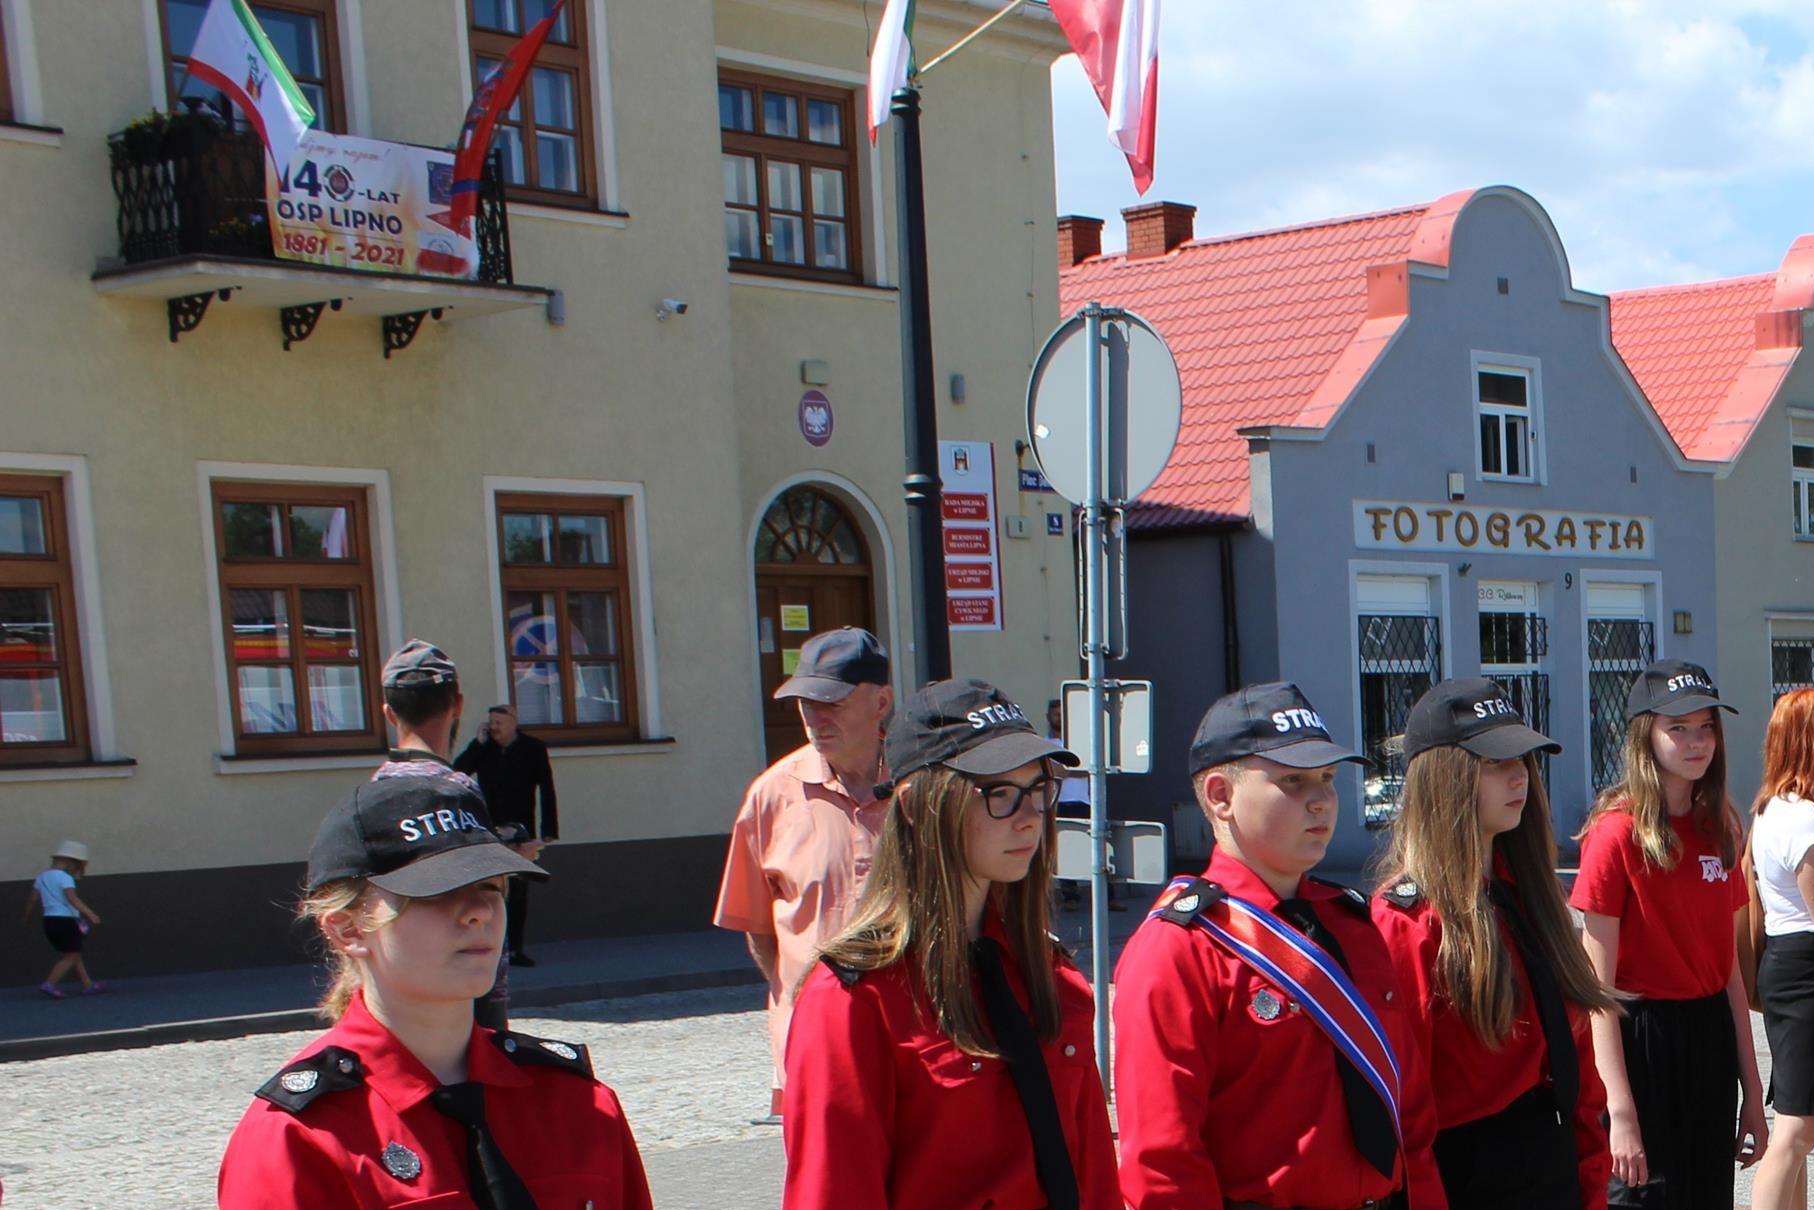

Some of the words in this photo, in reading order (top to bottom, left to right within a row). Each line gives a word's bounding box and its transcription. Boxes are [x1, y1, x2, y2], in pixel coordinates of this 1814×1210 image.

[277, 199, 323, 222] OSP
[330, 207, 402, 235] LIPNO
[284, 233, 330, 256] 1881
[351, 242, 405, 266] 2021
[1365, 505, 1645, 550] FOTOGRAFIA
[1564, 571, 1573, 590] 9
[966, 703, 1024, 730] STRA
